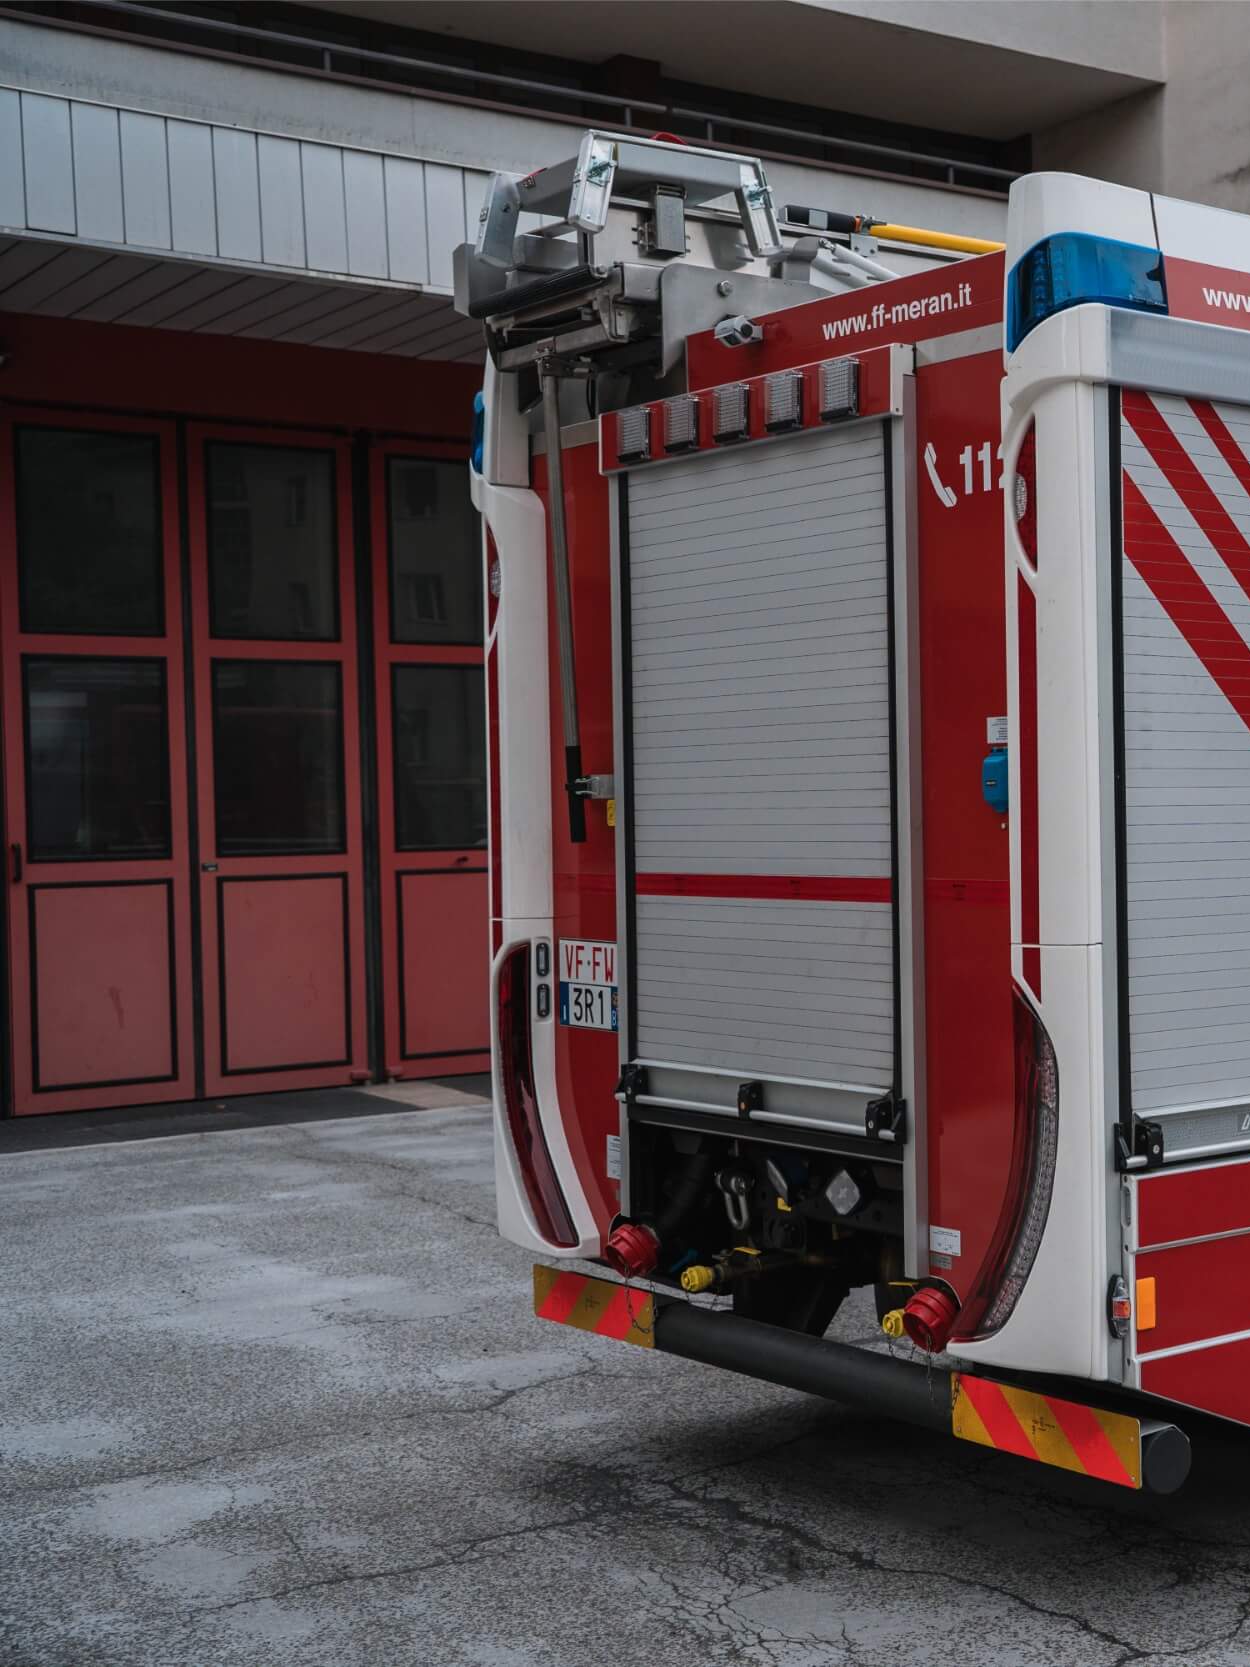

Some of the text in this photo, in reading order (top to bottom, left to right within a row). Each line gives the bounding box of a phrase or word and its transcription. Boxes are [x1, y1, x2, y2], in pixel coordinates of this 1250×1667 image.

[822, 283, 973, 341] www.ff-meran.it
[959, 441, 1004, 495] 11
[573, 987, 604, 1024] 3R1
